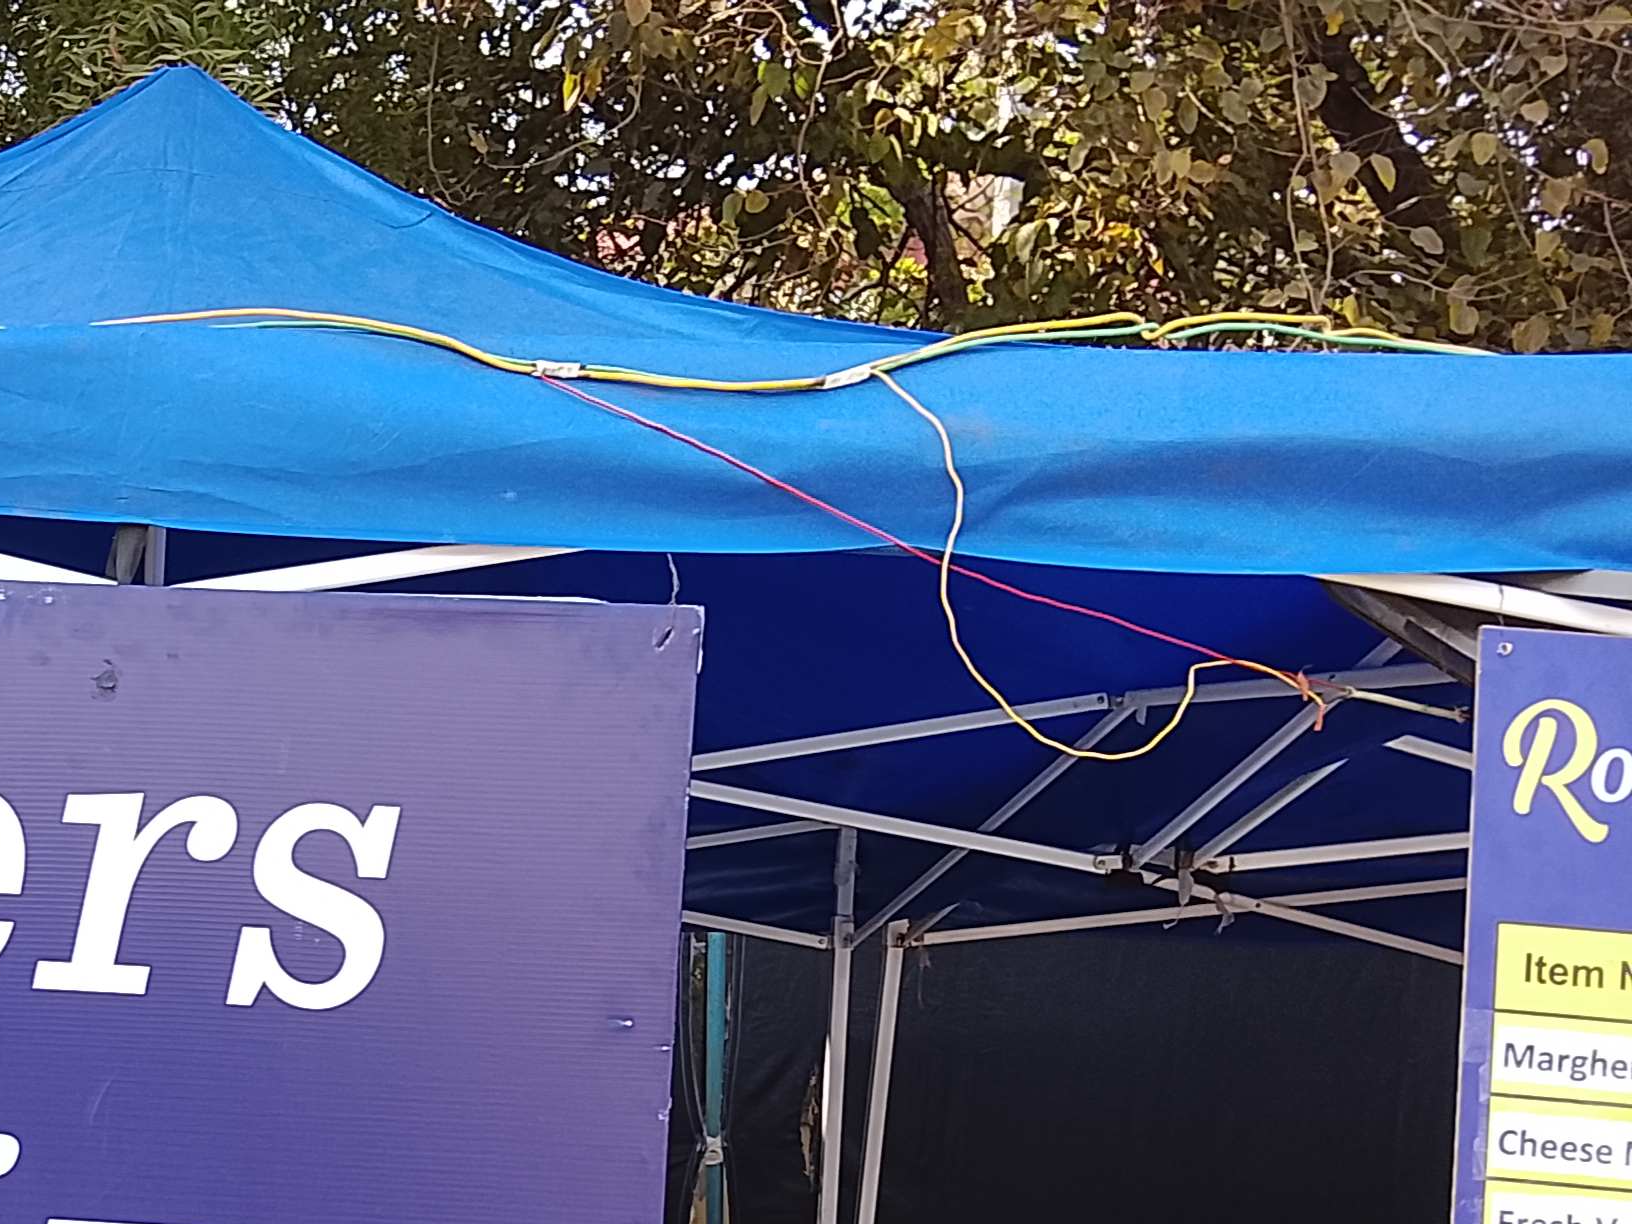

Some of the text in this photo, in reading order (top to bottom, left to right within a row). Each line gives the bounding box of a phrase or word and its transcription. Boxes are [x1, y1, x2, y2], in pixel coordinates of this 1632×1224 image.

[1524, 952, 1604, 989] Item
[1503, 1042, 1632, 1082] Marghe
[1498, 1129, 1613, 1165] Cheese
